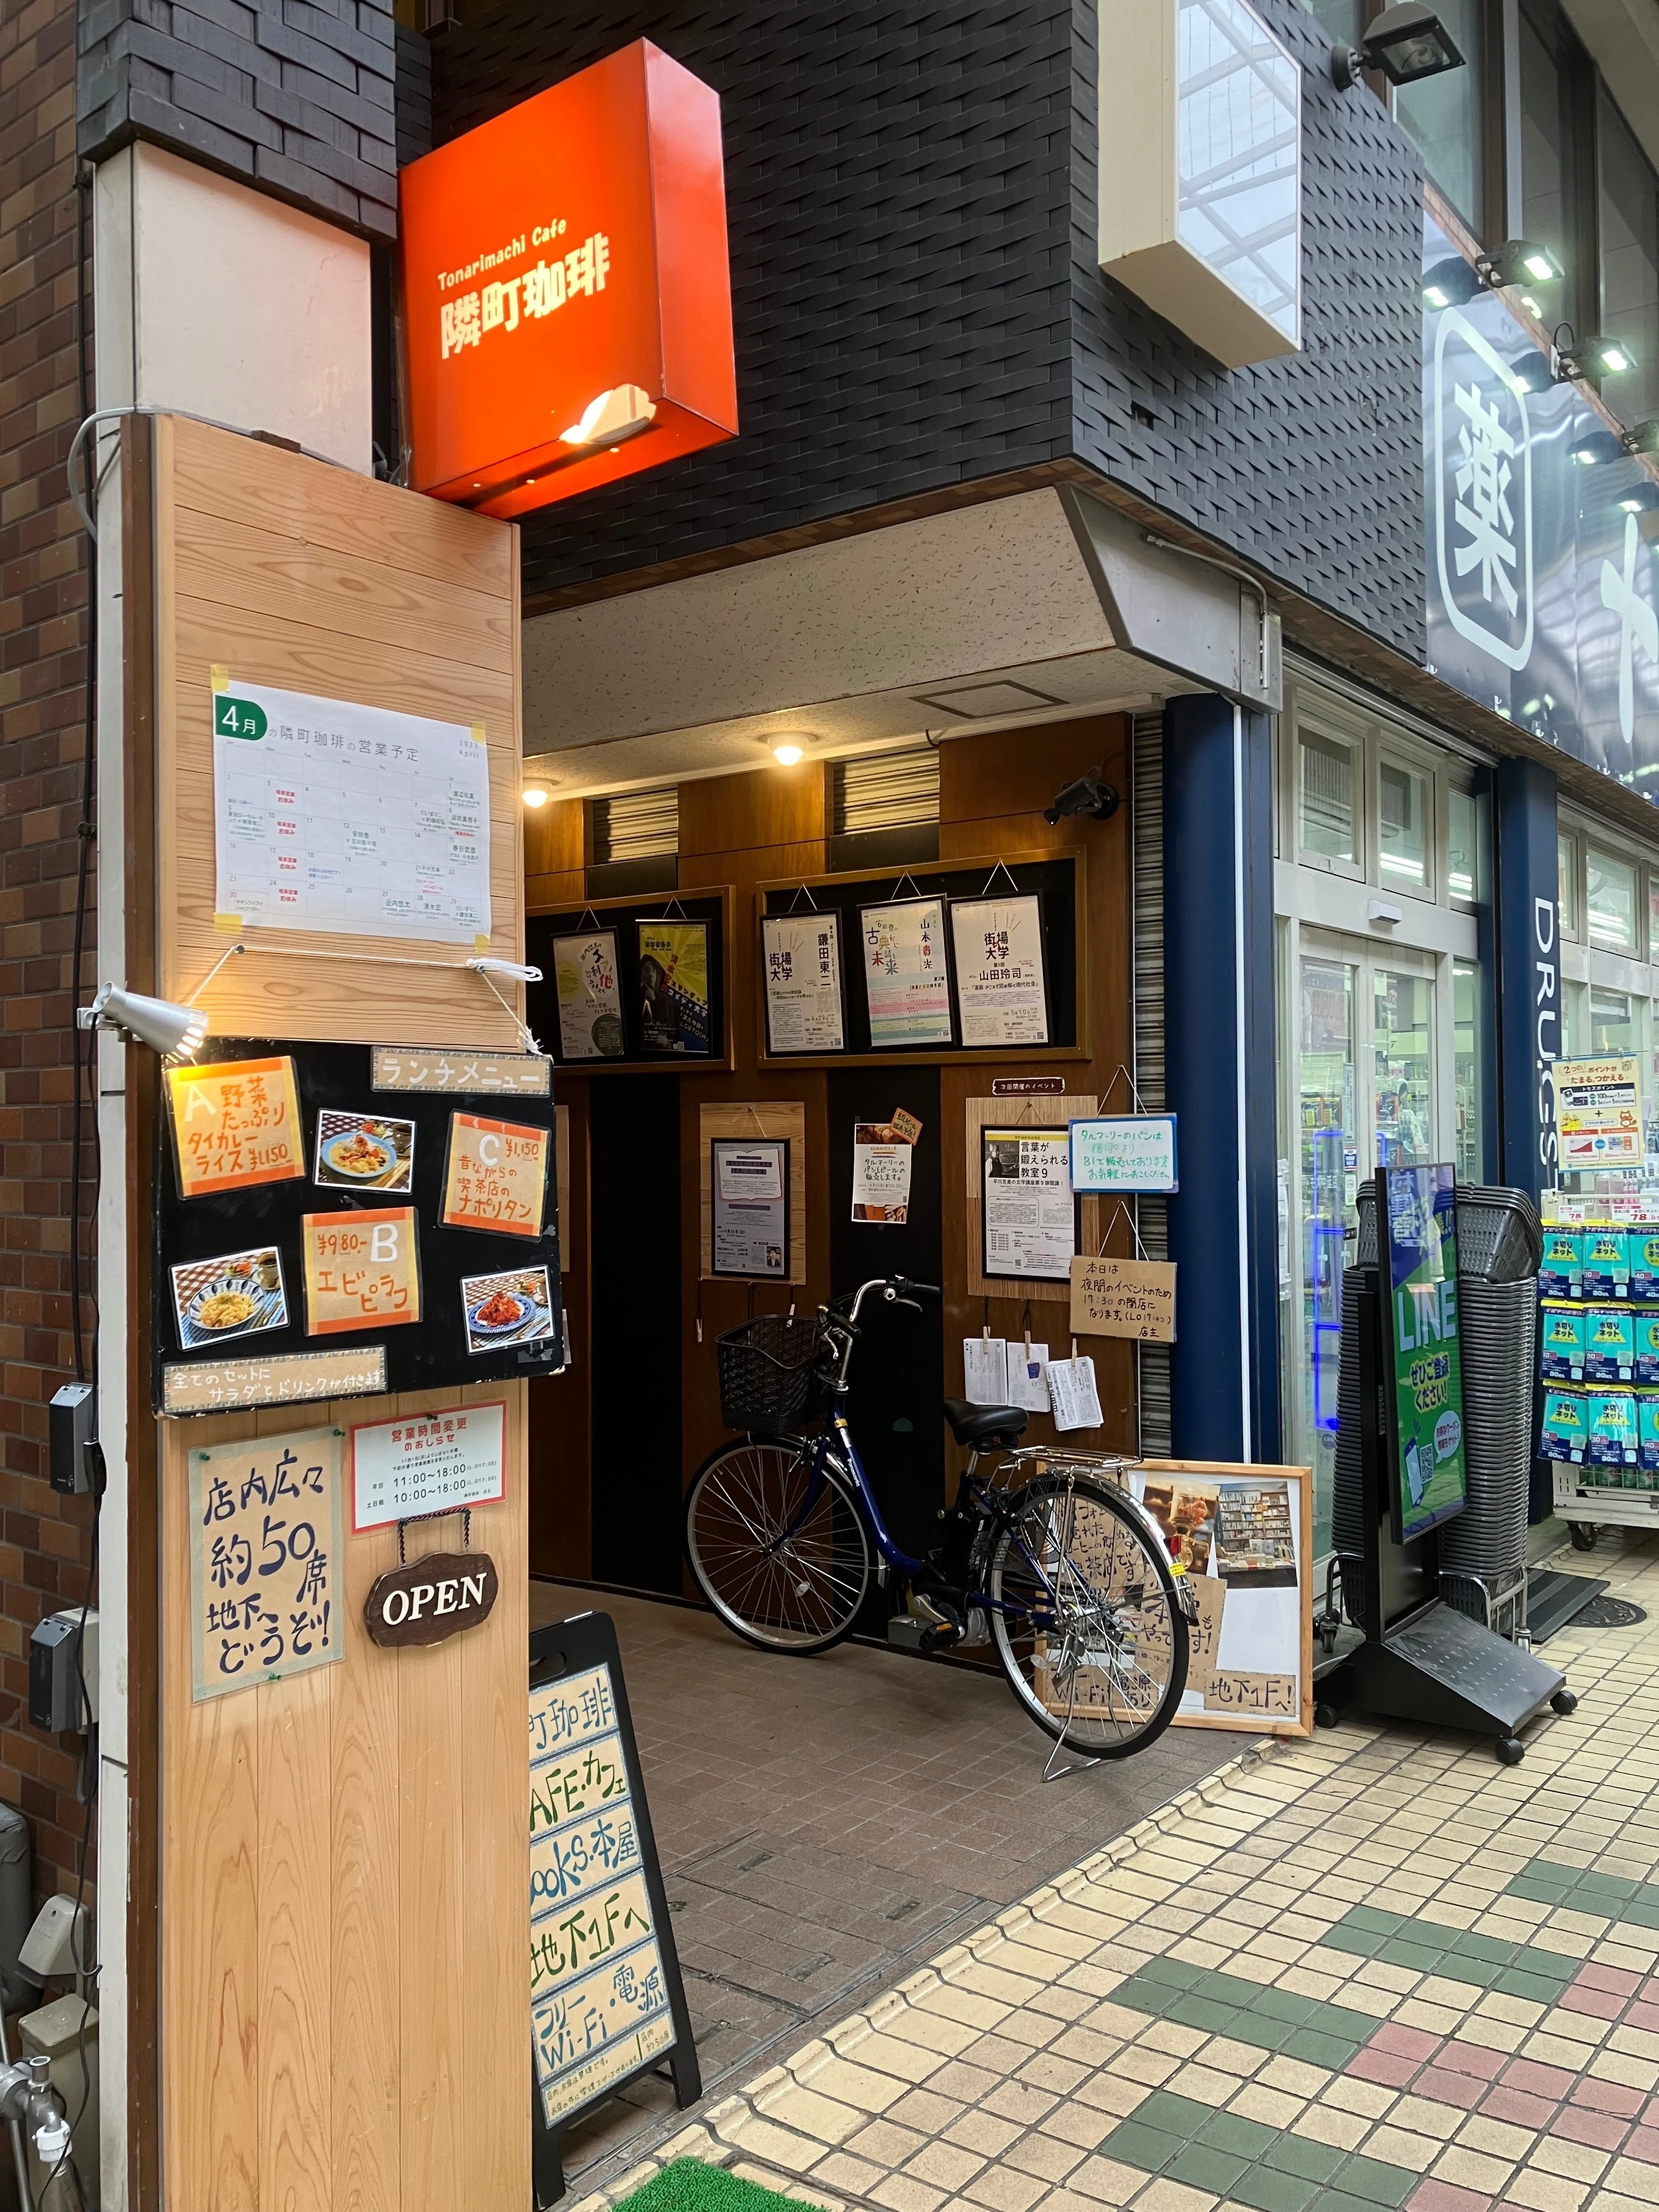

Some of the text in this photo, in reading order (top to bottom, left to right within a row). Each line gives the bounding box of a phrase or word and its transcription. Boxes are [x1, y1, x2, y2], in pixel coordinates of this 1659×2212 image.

[438, 218, 566, 290] Tonarimachi Cafe
[441, 232, 610, 359] 隣町珈琲
[1454, 382, 1519, 618] 薬
[459, 740, 478, 749] 2023
[459, 749, 479, 758] April
[920, 918, 933, 969] 山本貴光
[979, 968, 1021, 981] 山田玲司
[383, 1058, 540, 1088] ランチメニュー
[184, 1084, 218, 1122] A
[221, 1076, 267, 1108] 野菜
[222, 1102, 285, 1130] たっぷり
[188, 1132, 258, 1155] タイカレー
[1020, 1142, 1049, 1152] 言葉が
[1081, 1130, 1162, 1142] タルマーリーのパンは
[196, 1150, 244, 1175] ライス
[479, 1134, 500, 1166] C
[1020, 1154, 1068, 1165] 鍛えられる
[459, 1154, 517, 1179] 昔ながらの
[866, 1172, 901, 1181] 販売します。
[458, 1177, 510, 1197] 喫茶店の
[459, 1194, 532, 1220] ナポリタン
[370, 1223, 398, 1262] B
[1596, 1240, 1616, 1249] 水切り
[1086, 1261, 1119, 1274] 本日は
[318, 1271, 408, 1312] エビピラフ
[1080, 1277, 1172, 1299] 夜間のイベントのため
[1398, 1280, 1456, 1352] LINE
[1555, 1322, 1574, 1330] 水切り
[1599, 1322, 1620, 1330] 水切り
[1138, 1325, 1160, 1338] 店主
[1554, 1329, 1573, 1338] ネット
[1599, 1329, 1620, 1338] ネット
[1410, 1353, 1449, 1387] ぜひご登録
[1556, 1403, 1577, 1411] 水切り
[1556, 1410, 1576, 1419] ネット
[392, 1417, 467, 1443] 営業時間変更
[404, 1434, 455, 1452] のおしらせ
[847, 1458, 860, 1487] Panasonic
[204, 1449, 324, 1526] 店内広々
[382, 1572, 488, 1626] OPEN
[206, 1593, 279, 1633] 地下へ
[534, 1994, 586, 2040] フリー
[540, 2007, 607, 2070] Wi-Fi
